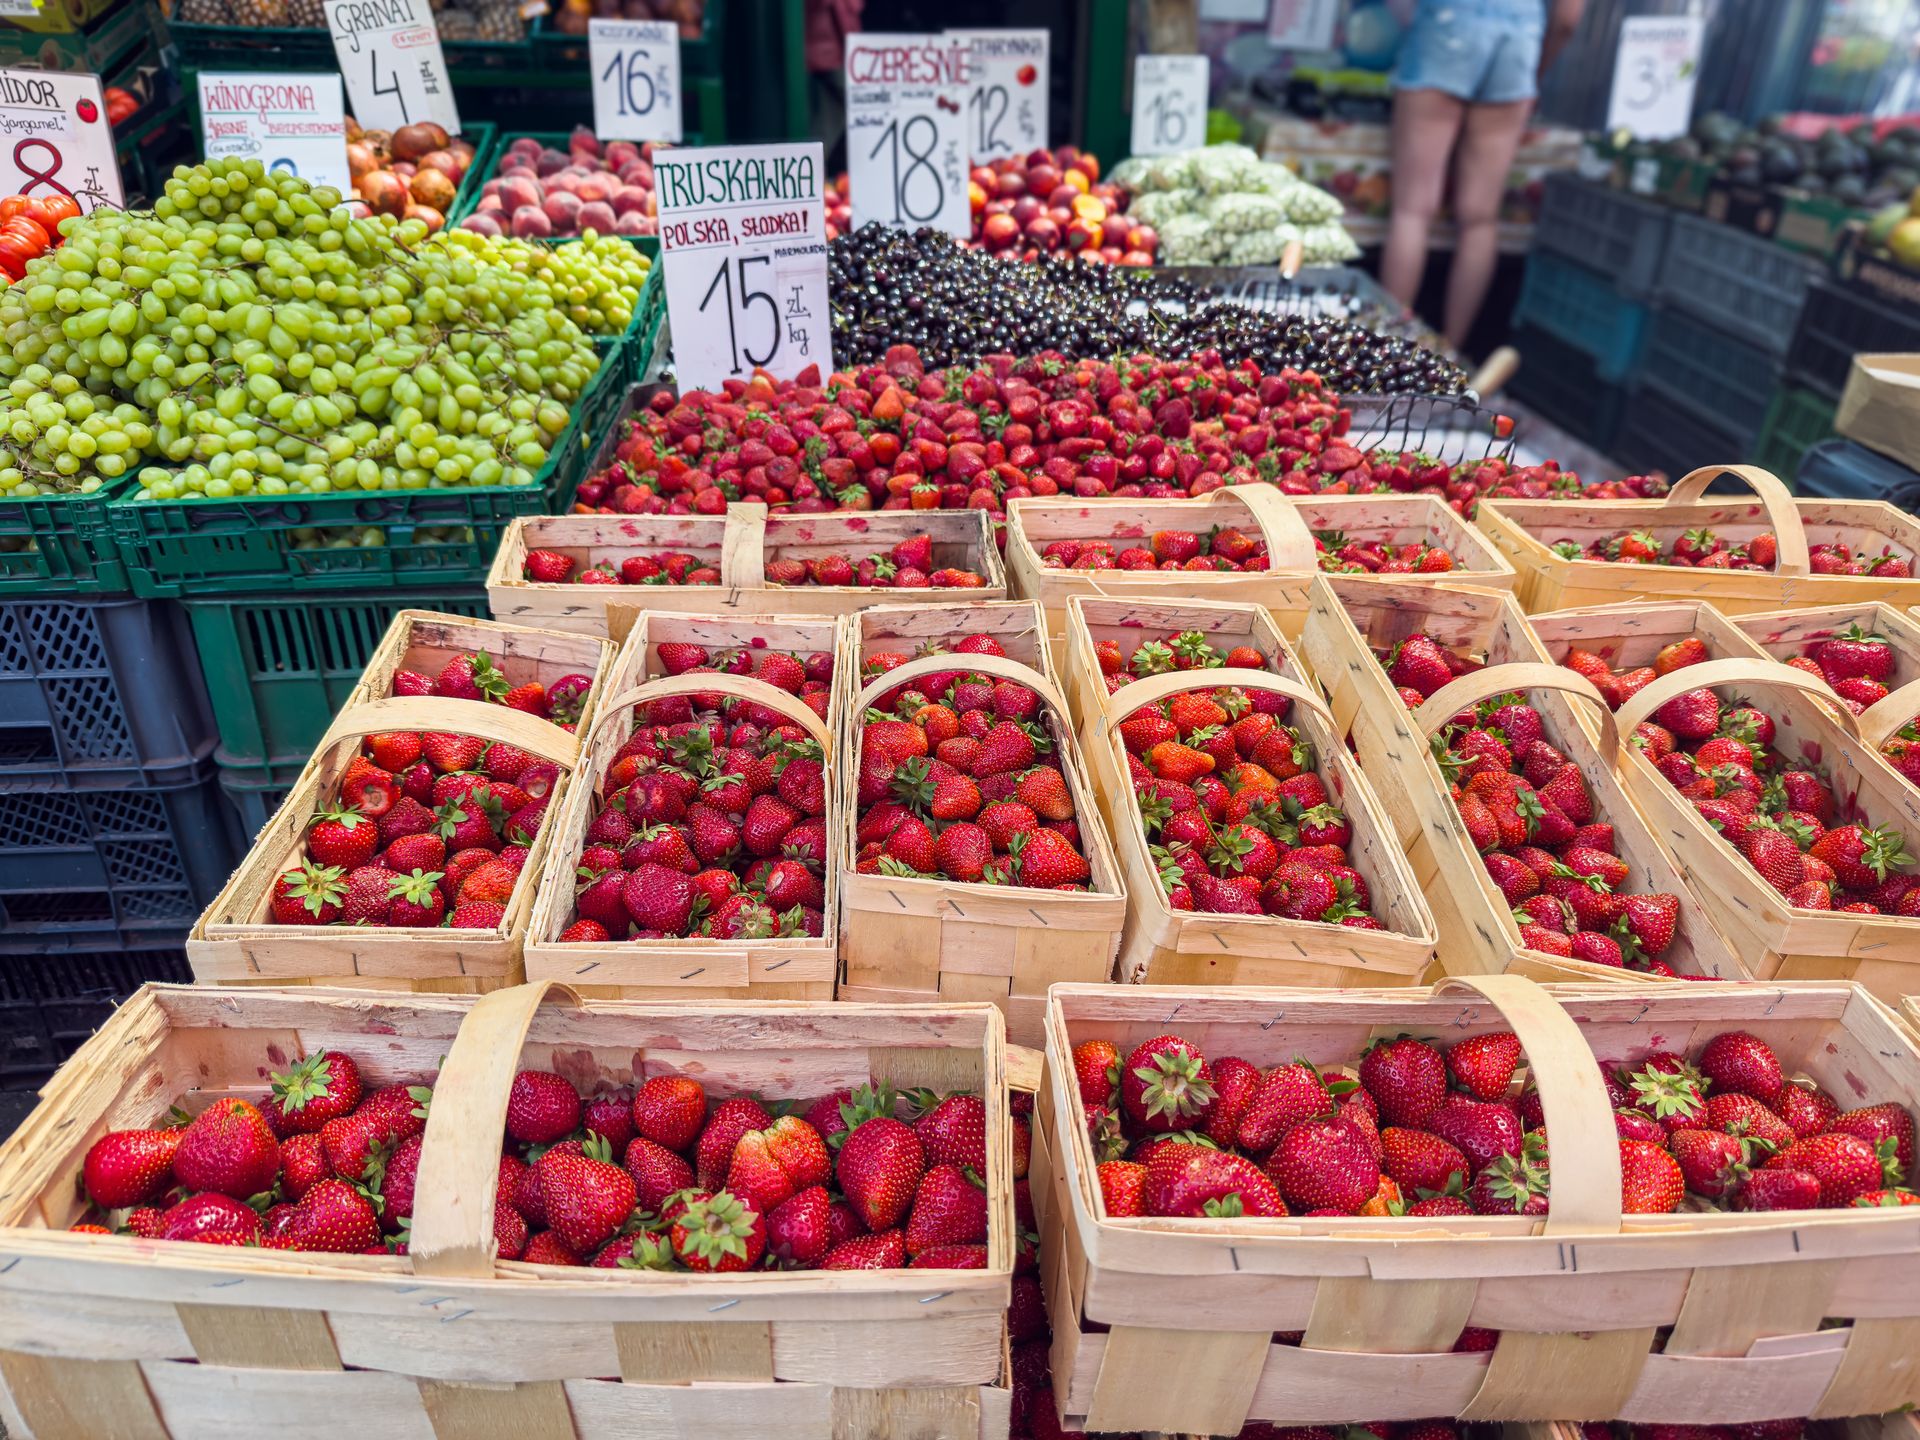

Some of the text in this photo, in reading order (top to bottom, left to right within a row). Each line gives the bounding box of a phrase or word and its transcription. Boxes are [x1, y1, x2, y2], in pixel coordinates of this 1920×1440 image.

[203, 80, 316, 125] WINOGRONA
[371, 49, 410, 125] 4
[602, 49, 656, 116] 16
[1624, 55, 1662, 111] 3
[969, 85, 1012, 152] 12
[1143, 90, 1187, 146] 16
[13, 138, 83, 215] 8
[654, 155, 816, 209] TRUSKAWKA
[869, 114, 945, 225] 18
[698, 256, 781, 376] 15
[788, 322, 811, 356] kg
